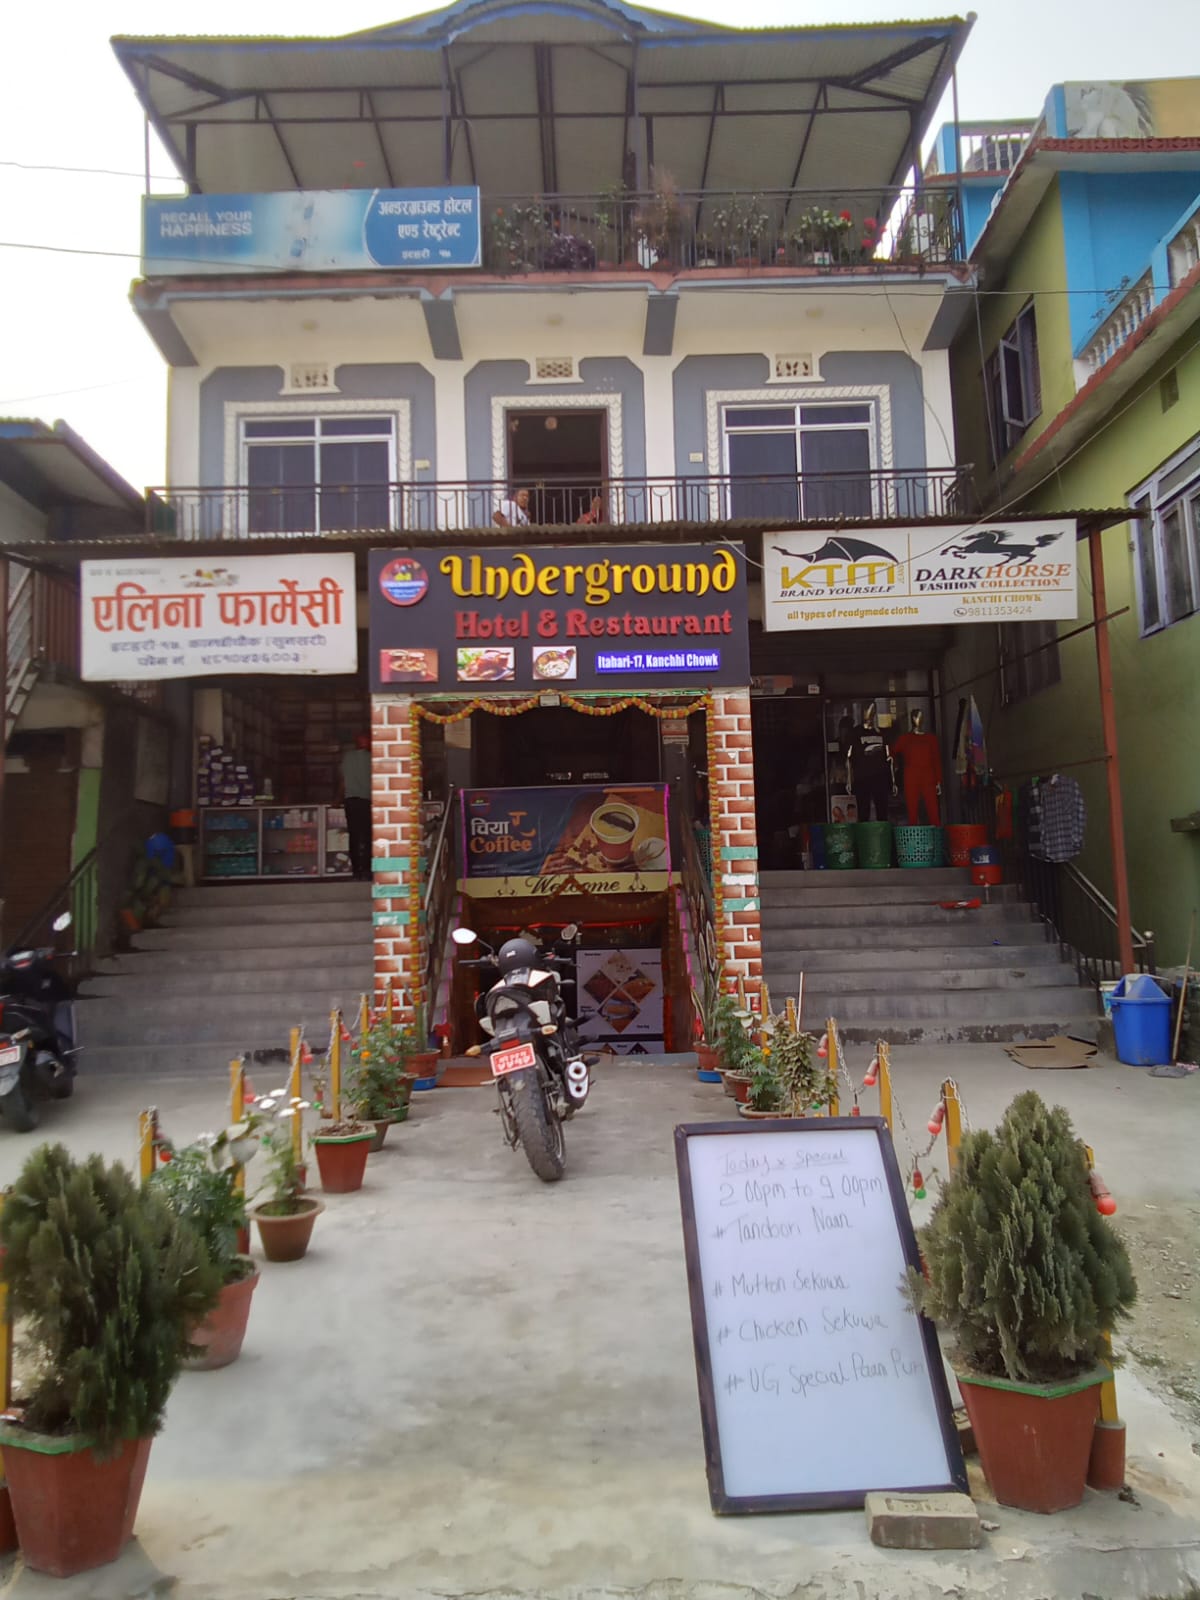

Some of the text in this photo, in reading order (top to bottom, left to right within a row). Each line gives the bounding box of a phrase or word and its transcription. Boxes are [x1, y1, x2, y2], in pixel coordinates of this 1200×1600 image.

[444, 197, 473, 215] होटल
[160, 210, 253, 223] RECALL YOUR
[160, 222, 253, 238] HAPPINESS
[439, 549, 737, 605] Underground
[781, 562, 896, 588] KTM
[779, 585, 895, 598] BRAND YOURSELF
[919, 579, 1061, 592] FASHION COLLECTION
[92, 582, 206, 632] एलिना
[217, 577, 344, 628] फार्मेसी
[961, 594, 1043, 605] KANCHI CHOWK
[787, 605, 919, 621] all types of readymade cloths
[967, 606, 1032, 617] 9811353424
[454, 608, 734, 639] Hotel & Restaurant
[598, 653, 719, 669] Itahari-17, Kanchhi Chowk
[470, 817, 511, 837] चिया
[470, 835, 533, 854] Coffee
[793, 1178, 813, 1198] to
[731, 1272, 787, 1297] Mutton
[738, 1317, 809, 1342] Chicken
[821, 1306, 889, 1334] Sekuwa
[788, 1361, 850, 1398] Special
